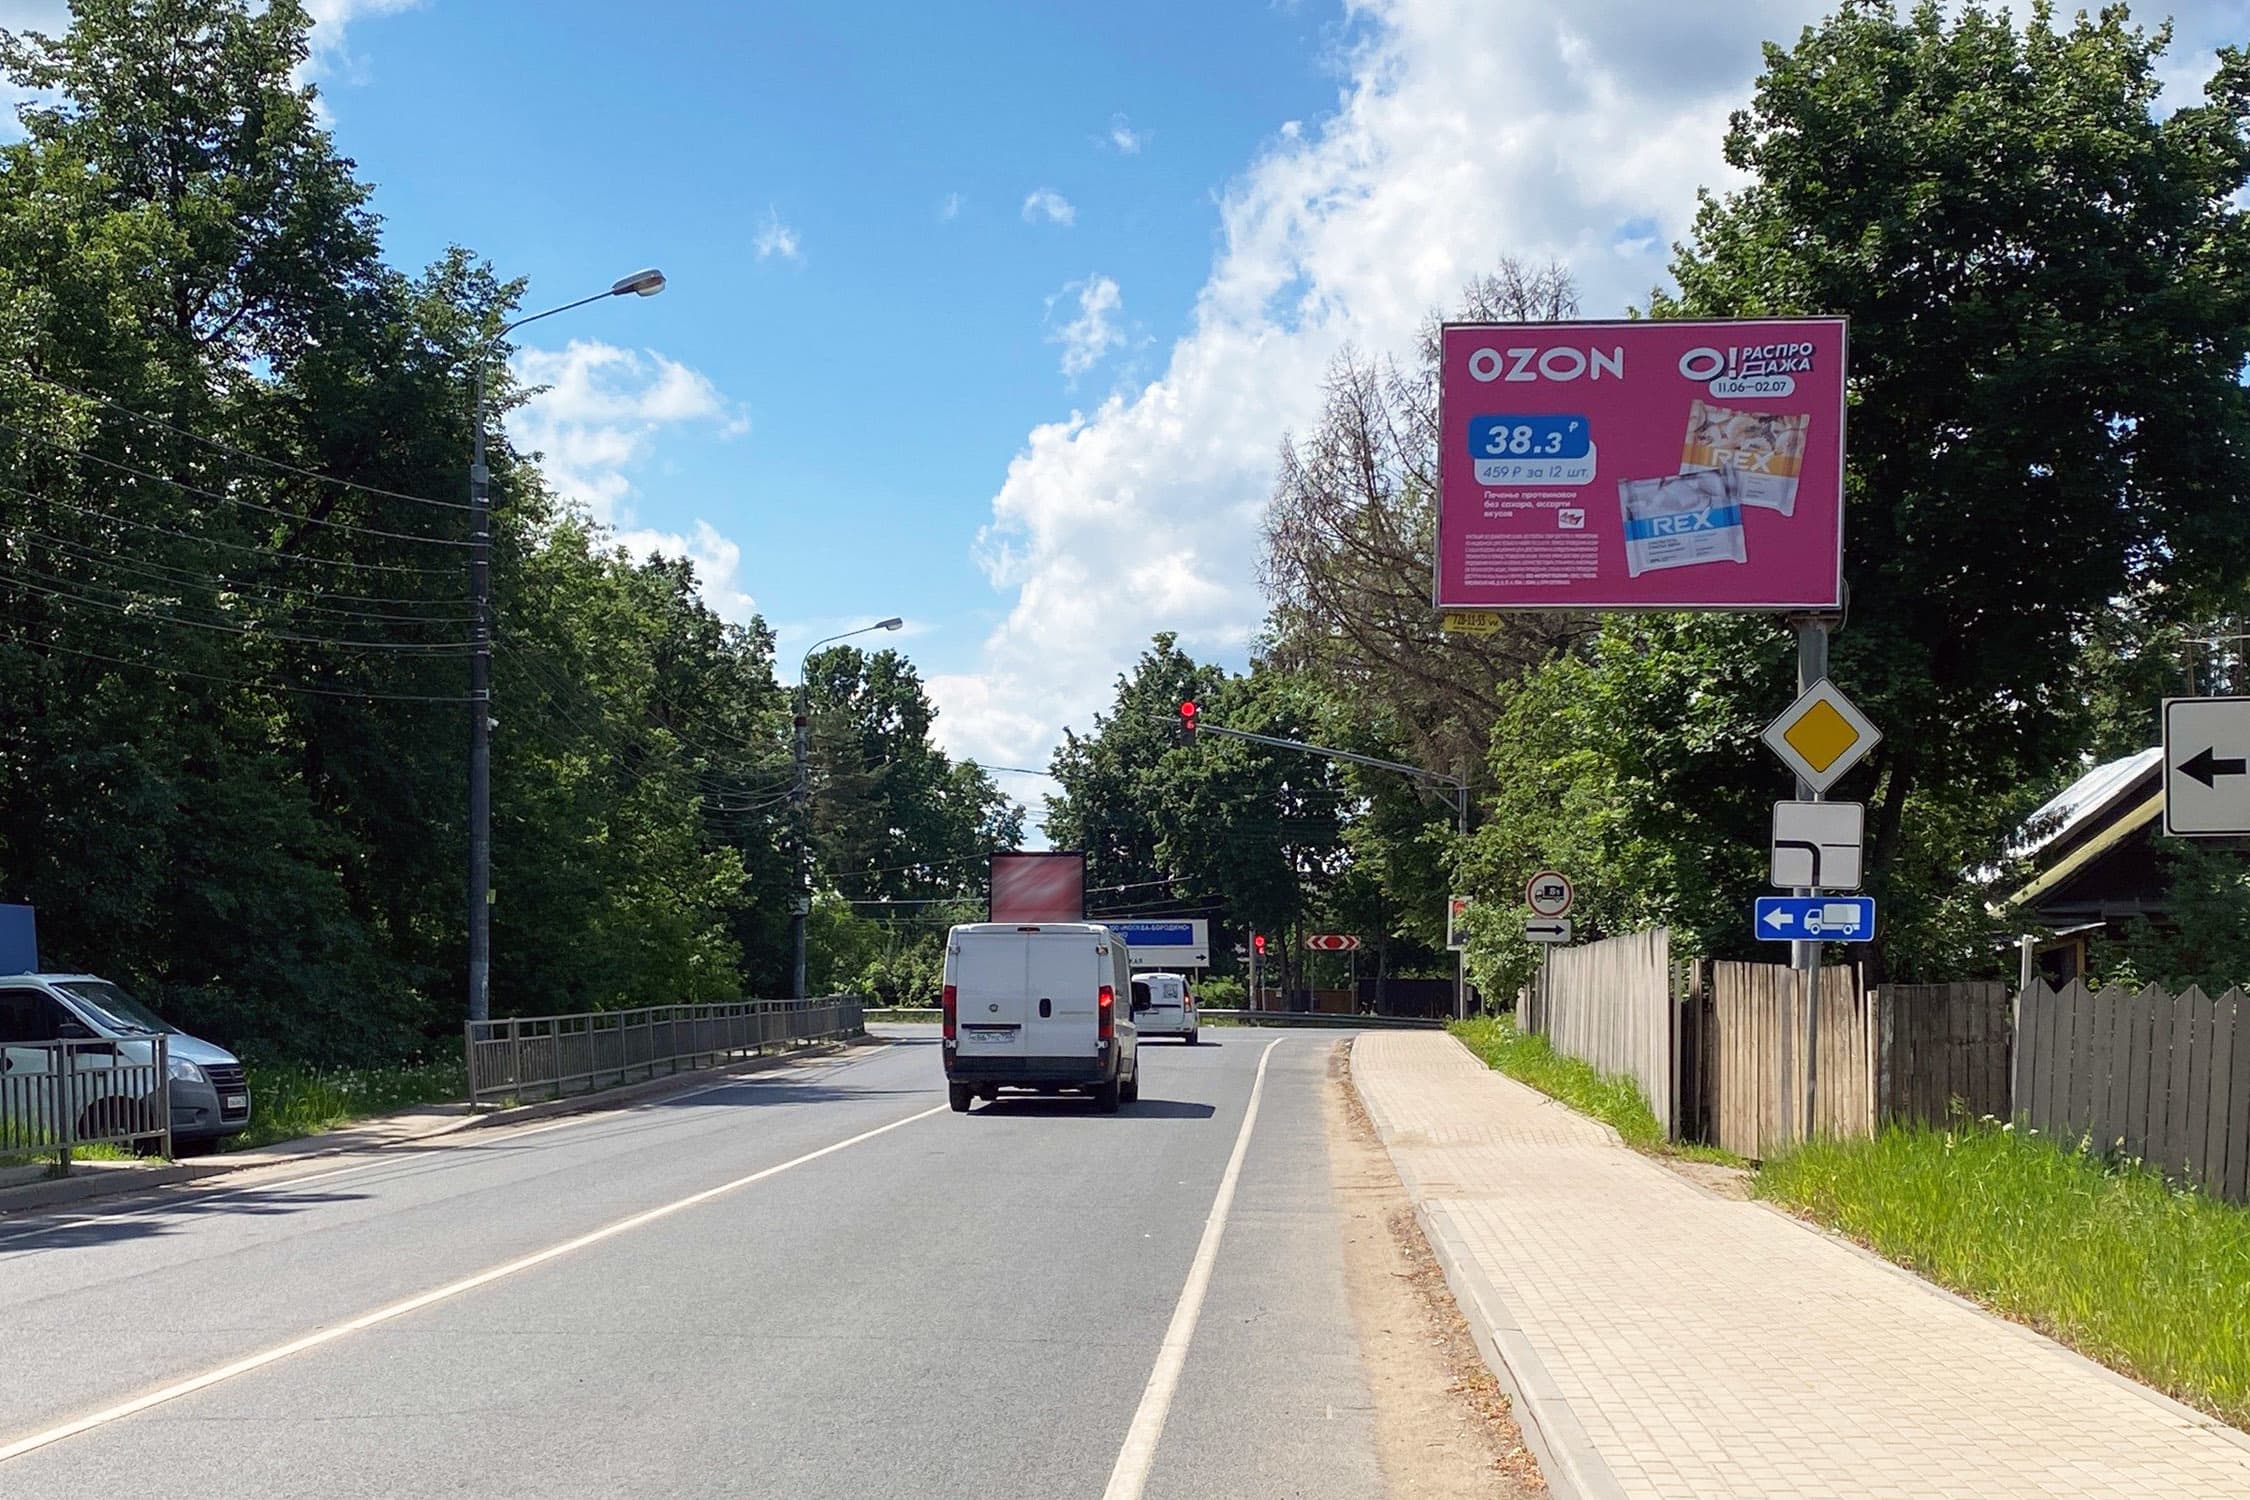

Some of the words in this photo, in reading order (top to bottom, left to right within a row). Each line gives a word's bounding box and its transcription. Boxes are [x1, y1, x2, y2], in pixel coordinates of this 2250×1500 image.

[1742, 342, 1814, 361] РАСПРО
[1468, 346, 1624, 382] OZON
[1739, 358, 1811, 379] ДАЖА
[1712, 449, 1776, 473] REX
[1483, 466, 1509, 479] 459
[1526, 468, 1544, 479] за
[1549, 465, 1562, 478] 12
[1484, 491, 1520, 499] Печенье
[1484, 511, 1513, 519] вкусов
[1653, 507, 1715, 536] REX
